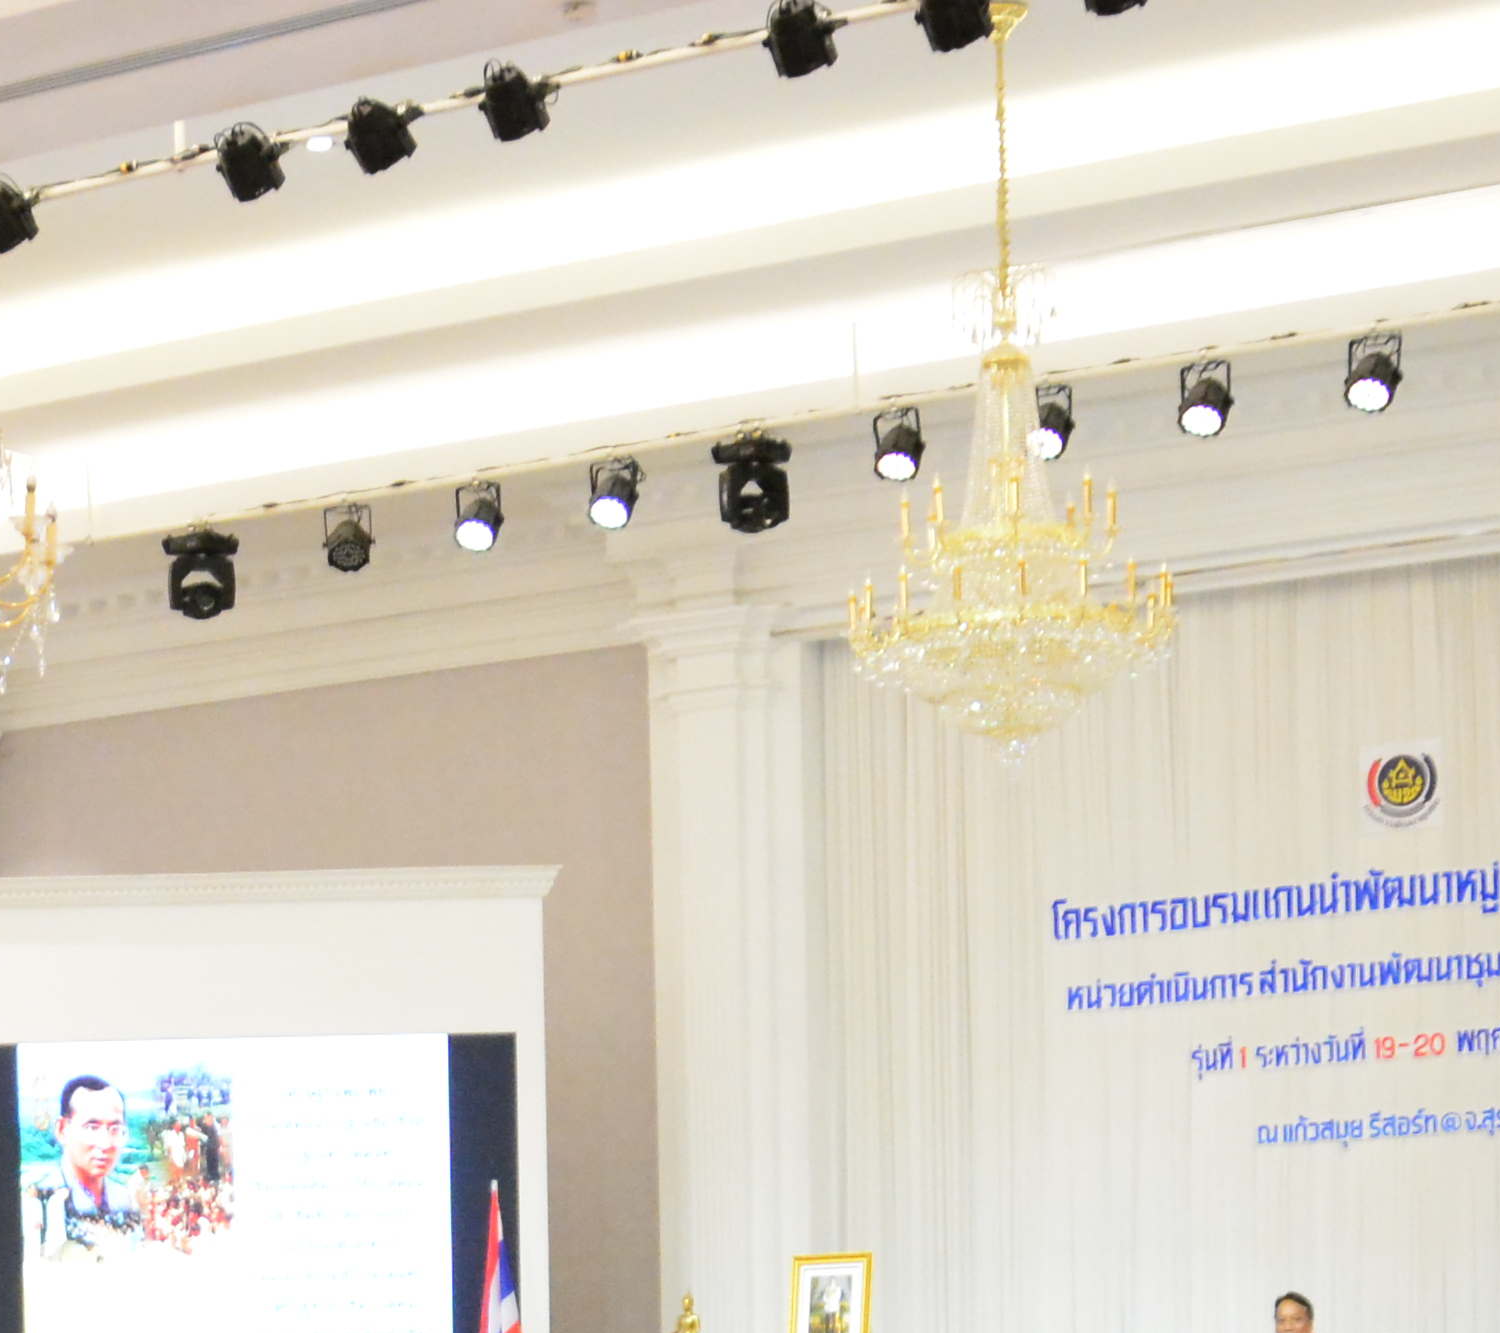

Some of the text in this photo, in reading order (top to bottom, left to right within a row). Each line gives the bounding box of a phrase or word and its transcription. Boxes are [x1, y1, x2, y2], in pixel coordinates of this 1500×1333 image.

[1066, 971, 1254, 1011] หน่วยดำเนินการ
